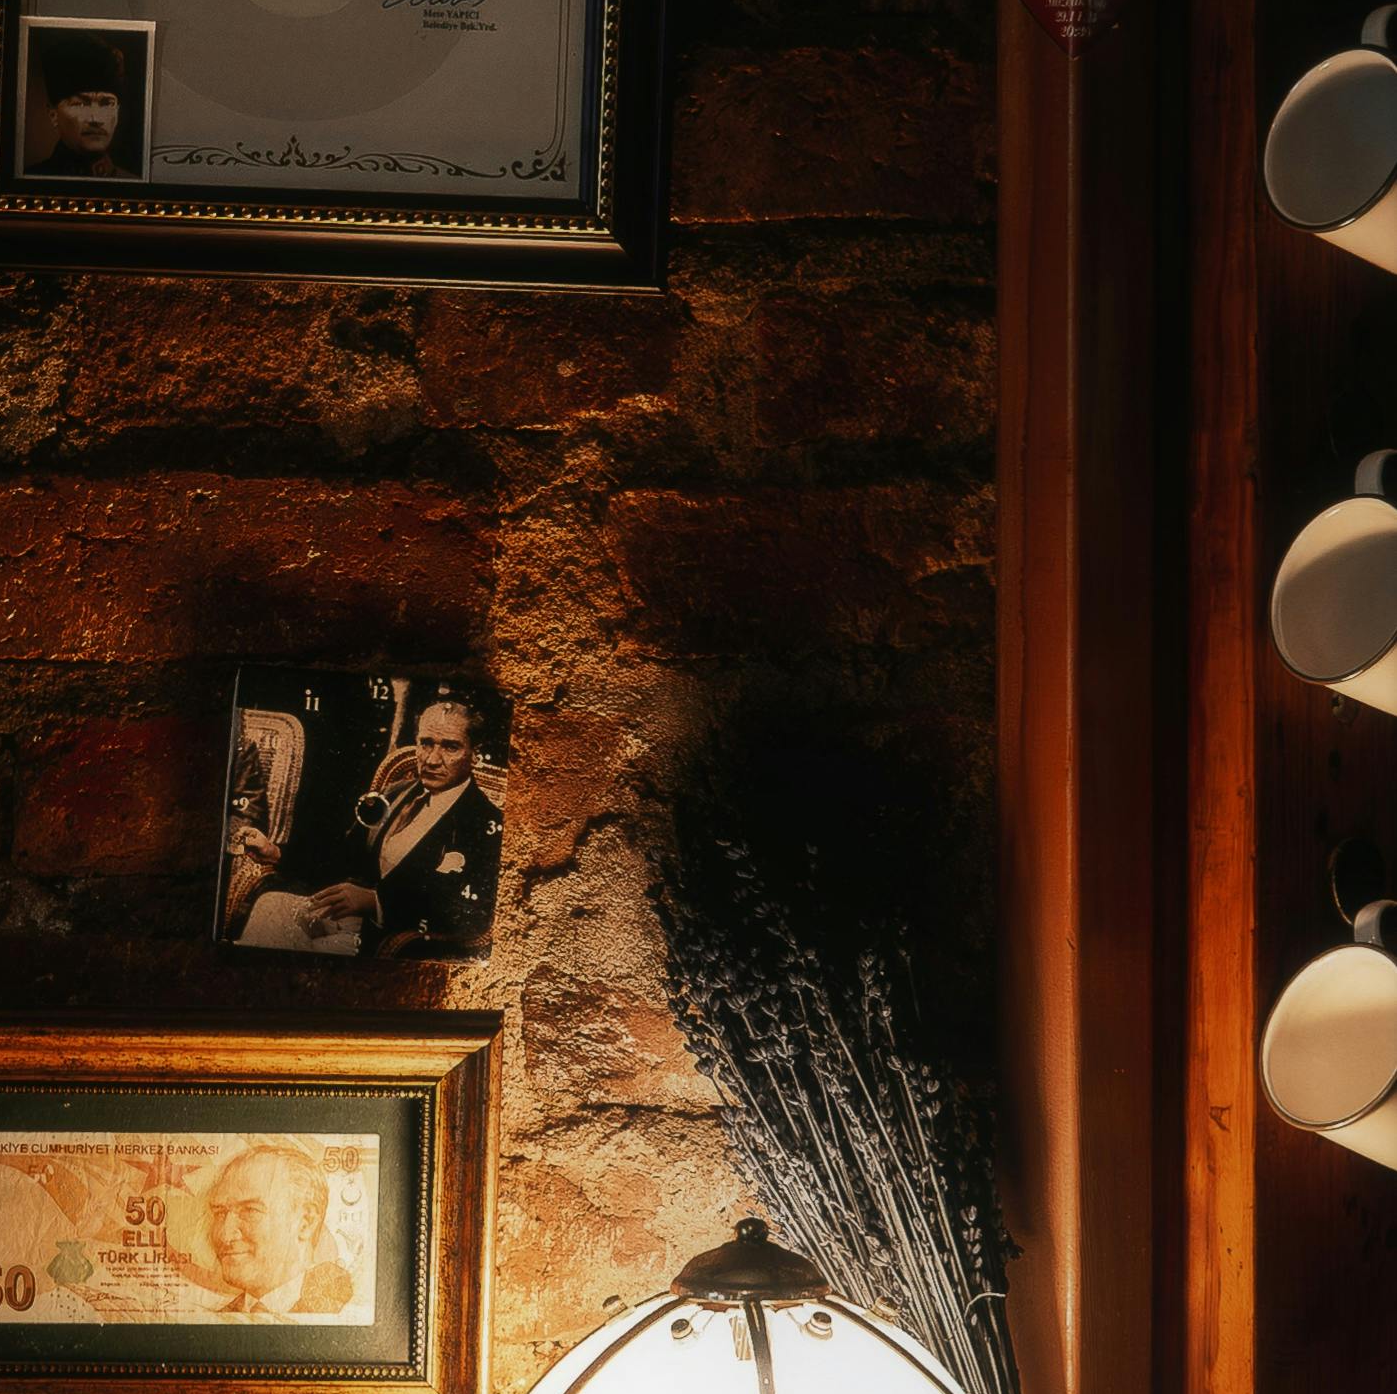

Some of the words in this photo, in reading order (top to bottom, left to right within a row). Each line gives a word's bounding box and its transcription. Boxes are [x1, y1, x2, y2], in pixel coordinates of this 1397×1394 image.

[370, 684, 390, 701] 12
[485, 820, 498, 836] 3
[460, 884, 472, 899] 4
[31, 1142, 110, 1155] CUMHURİYET
[114, 1144, 164, 1156] MERKEZ
[167, 1145, 219, 1156] BANKASI
[323, 1145, 360, 1173] 50
[124, 1196, 166, 1227] 50
[122, 1227, 168, 1249] ELLİ
[98, 1250, 139, 1265] TÜRK
[143, 1250, 193, 1265] LİRASI
